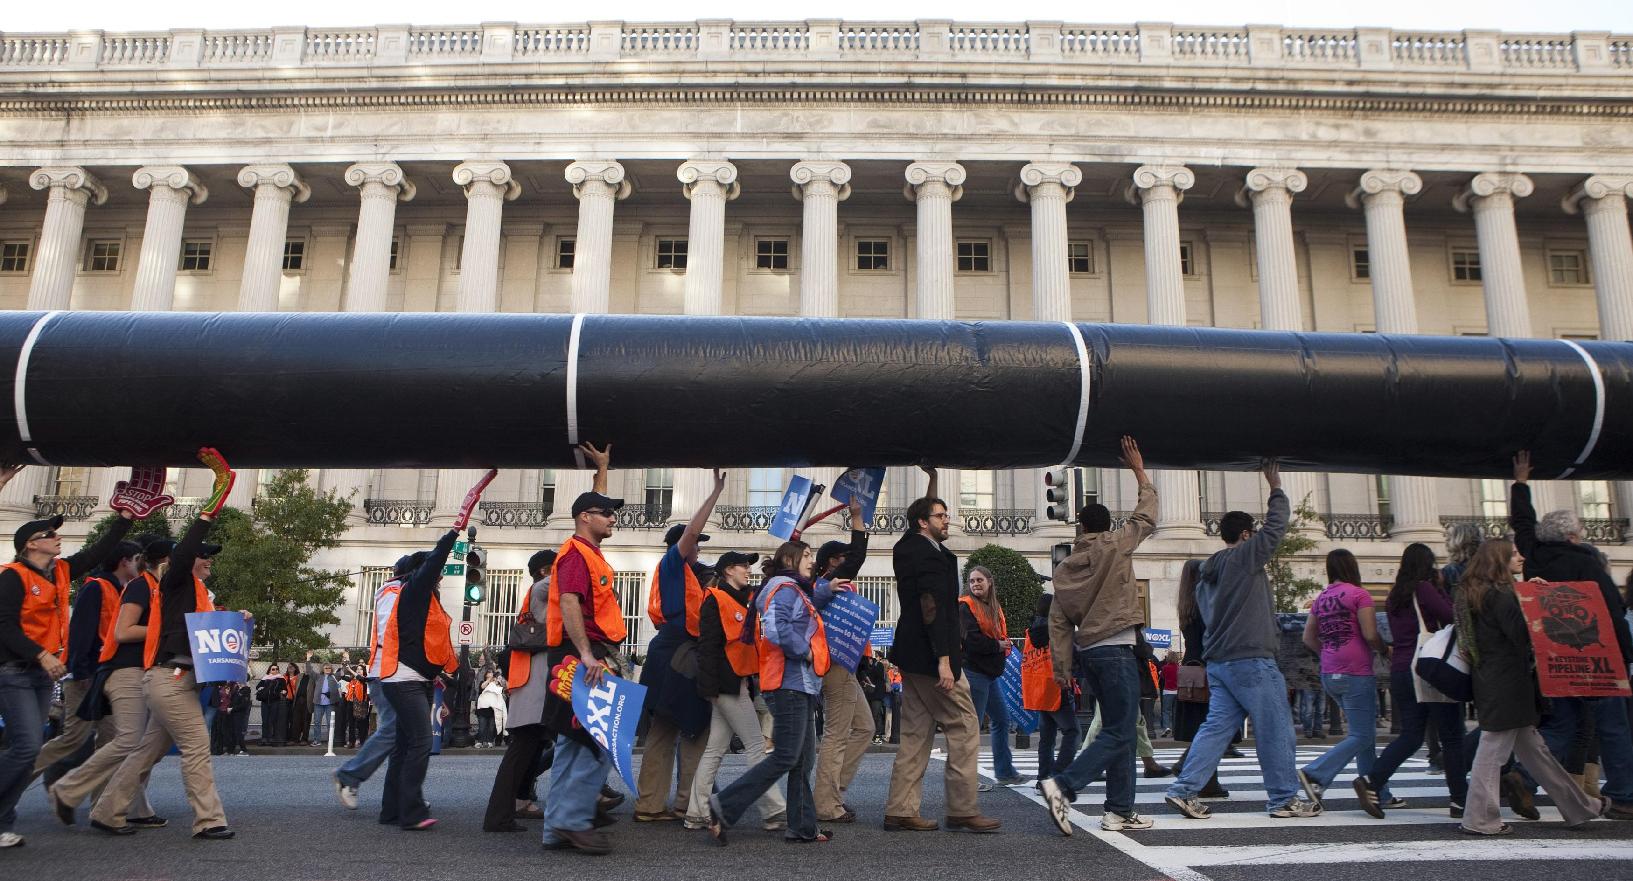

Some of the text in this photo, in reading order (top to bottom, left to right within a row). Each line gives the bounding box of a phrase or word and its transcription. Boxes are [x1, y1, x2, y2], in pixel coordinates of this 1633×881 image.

[127, 489, 152, 501] STOP
[1145, 632, 1171, 642] NOXL
[1548, 663, 1591, 673] PIPELINE
[1590, 656, 1616, 673] XL
[587, 681, 617, 750] OXL
